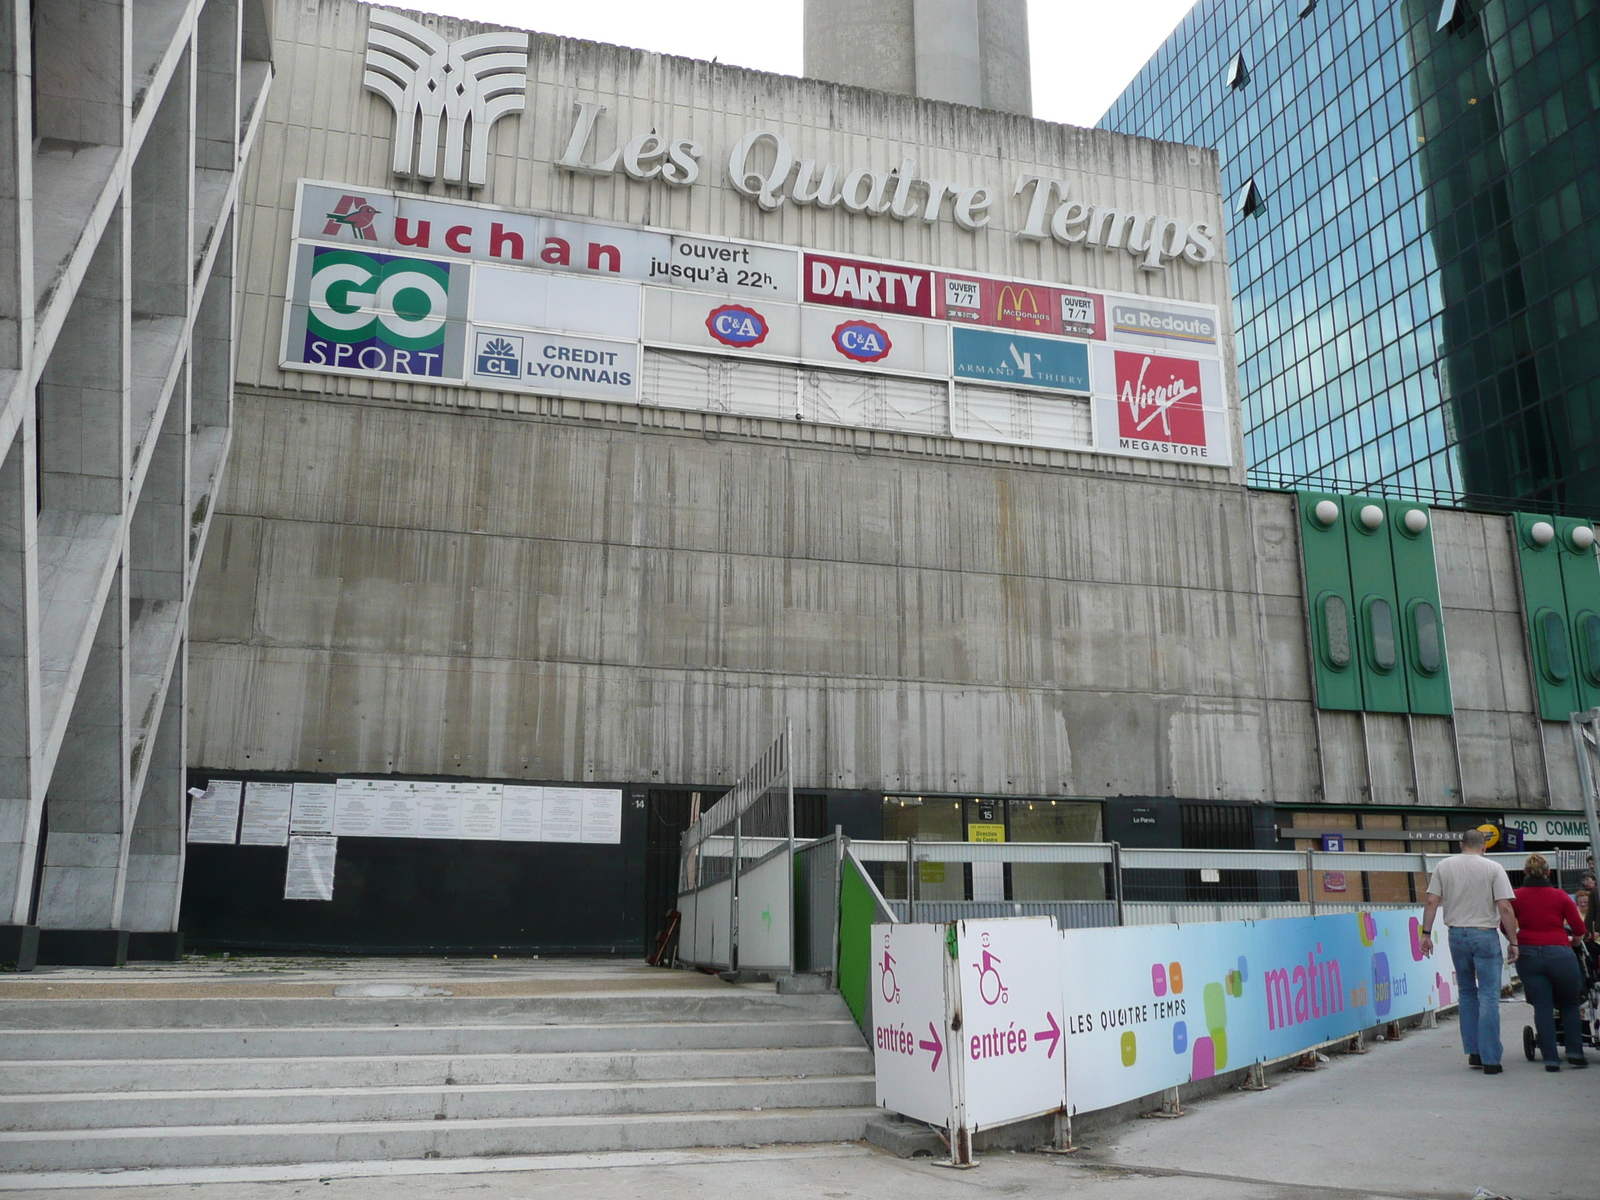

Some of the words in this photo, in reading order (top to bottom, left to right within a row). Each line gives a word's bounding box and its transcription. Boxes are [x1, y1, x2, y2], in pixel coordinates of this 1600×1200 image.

[555, 101, 702, 187] Les
[729, 131, 993, 231] Quatre
[1014, 173, 1216, 272] Temps
[322, 195, 621, 273] Auchan
[680, 243, 749, 264] ouvert
[812, 262, 922, 307] DARTY
[949, 282, 977, 293] OUVERT
[309, 263, 449, 338] GO
[954, 293, 973, 304] 7/7
[1064, 298, 1091, 308] OUVERT
[1068, 308, 1087, 319] 7/7
[1116, 309, 1136, 325] La
[1140, 312, 1211, 334] Redoute
[716, 315, 758, 337] C&A
[842, 331, 883, 353] C&A
[310, 341, 439, 377] SPORT
[486, 359, 511, 373] CL
[543, 345, 618, 366] CREDIT
[527, 362, 632, 386] LYONNAIS
[958, 363, 1014, 376] ARMAND
[1037, 372, 1083, 384] THIERY
[1121, 356, 1198, 436] Virgin
[1119, 439, 1208, 457] MEGASTORE
[983, 811, 993, 820] 15
[1429, 832, 1465, 840] POSTE
[1514, 821, 1538, 835] 260
[1546, 821, 1600, 836] COMME
[1264, 942, 1344, 1031] matin
[1392, 972, 1408, 997] tard
[1070, 1013, 1093, 1035] LES
[1153, 999, 1186, 1020] TEMPS
[876, 1023, 914, 1056] entrée
[970, 1022, 1027, 1060] entrée
